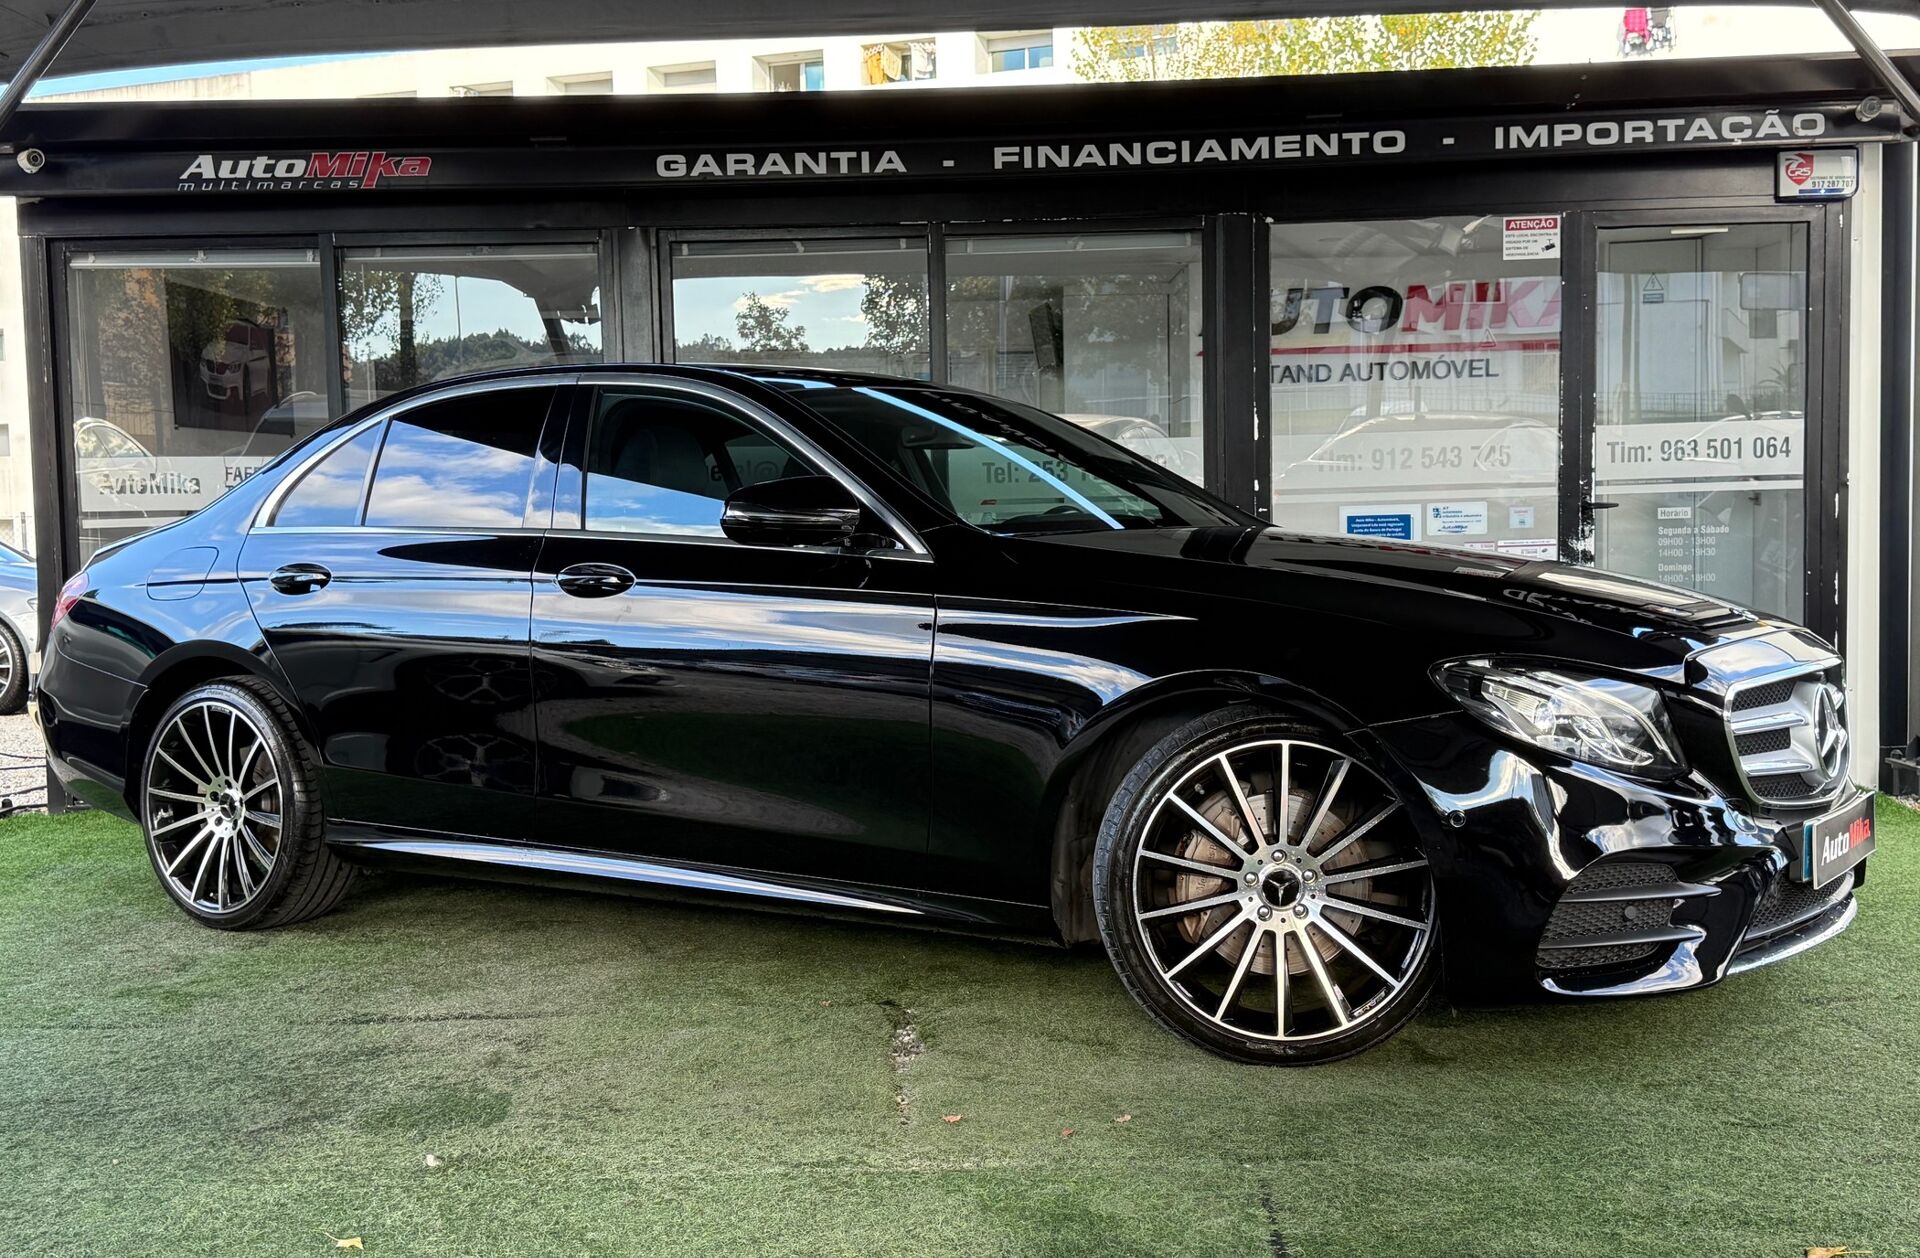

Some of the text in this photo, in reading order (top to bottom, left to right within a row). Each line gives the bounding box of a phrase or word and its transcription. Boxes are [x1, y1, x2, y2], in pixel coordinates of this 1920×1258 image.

[656, 150, 907, 177] GARANTIA
[993, 130, 1406, 170] FINANCIAMENTO
[1495, 109, 1825, 150] IMPORTAÇÃO
[179, 152, 432, 189] AutoMika
[177, 180, 359, 192] multimarcas
[1508, 218, 1555, 230] ATENÇÃO
[1271, 278, 1561, 336] UTOMIK
[1270, 354, 1500, 384] TAND AUTOMÓVEL
[1371, 447, 1413, 471] 912
[1421, 446, 1463, 468] 543
[1660, 438, 1699, 461] 963
[1706, 437, 1743, 459] 501
[1753, 436, 1792, 459] 064
[982, 462, 1019, 483] Tel:
[100, 472, 200, 495] AutoMika
[1658, 526, 1692, 536] Segunda
[1700, 524, 1730, 534] Sábado
[1658, 537, 1683, 546] 09H00
[1658, 548, 1683, 557] 14H00
[1691, 547, 1716, 556] 19H30
[1658, 563, 1692, 573] Domingo
[1658, 574, 1683, 583] 14H00
